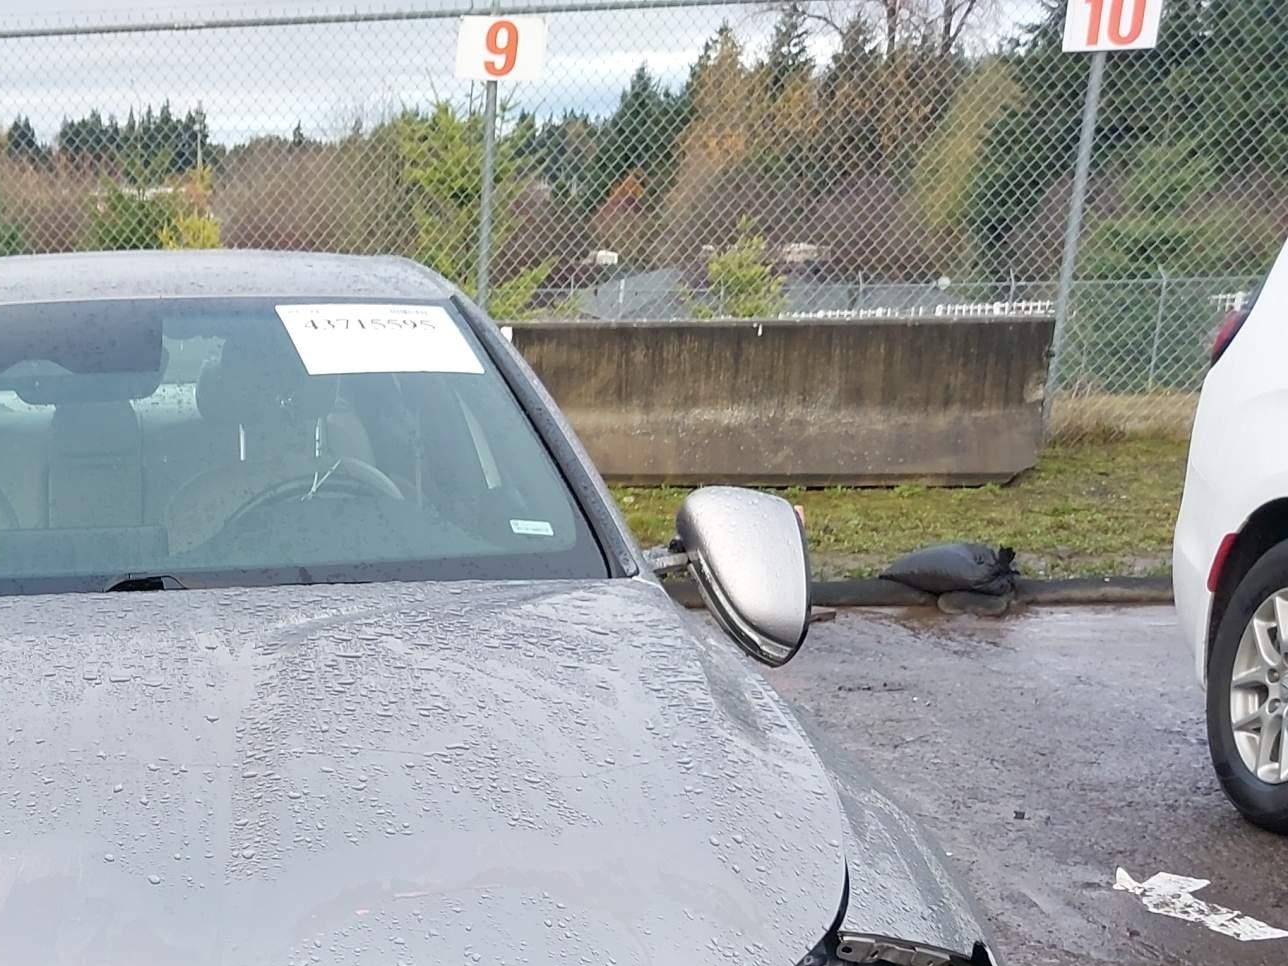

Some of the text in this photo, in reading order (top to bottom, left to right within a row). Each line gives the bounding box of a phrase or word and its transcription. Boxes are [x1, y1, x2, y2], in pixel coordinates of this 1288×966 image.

[1085, 0, 1146, 45] 10
[485, 20, 519, 77] 9
[304, 318, 436, 331] 43715595
